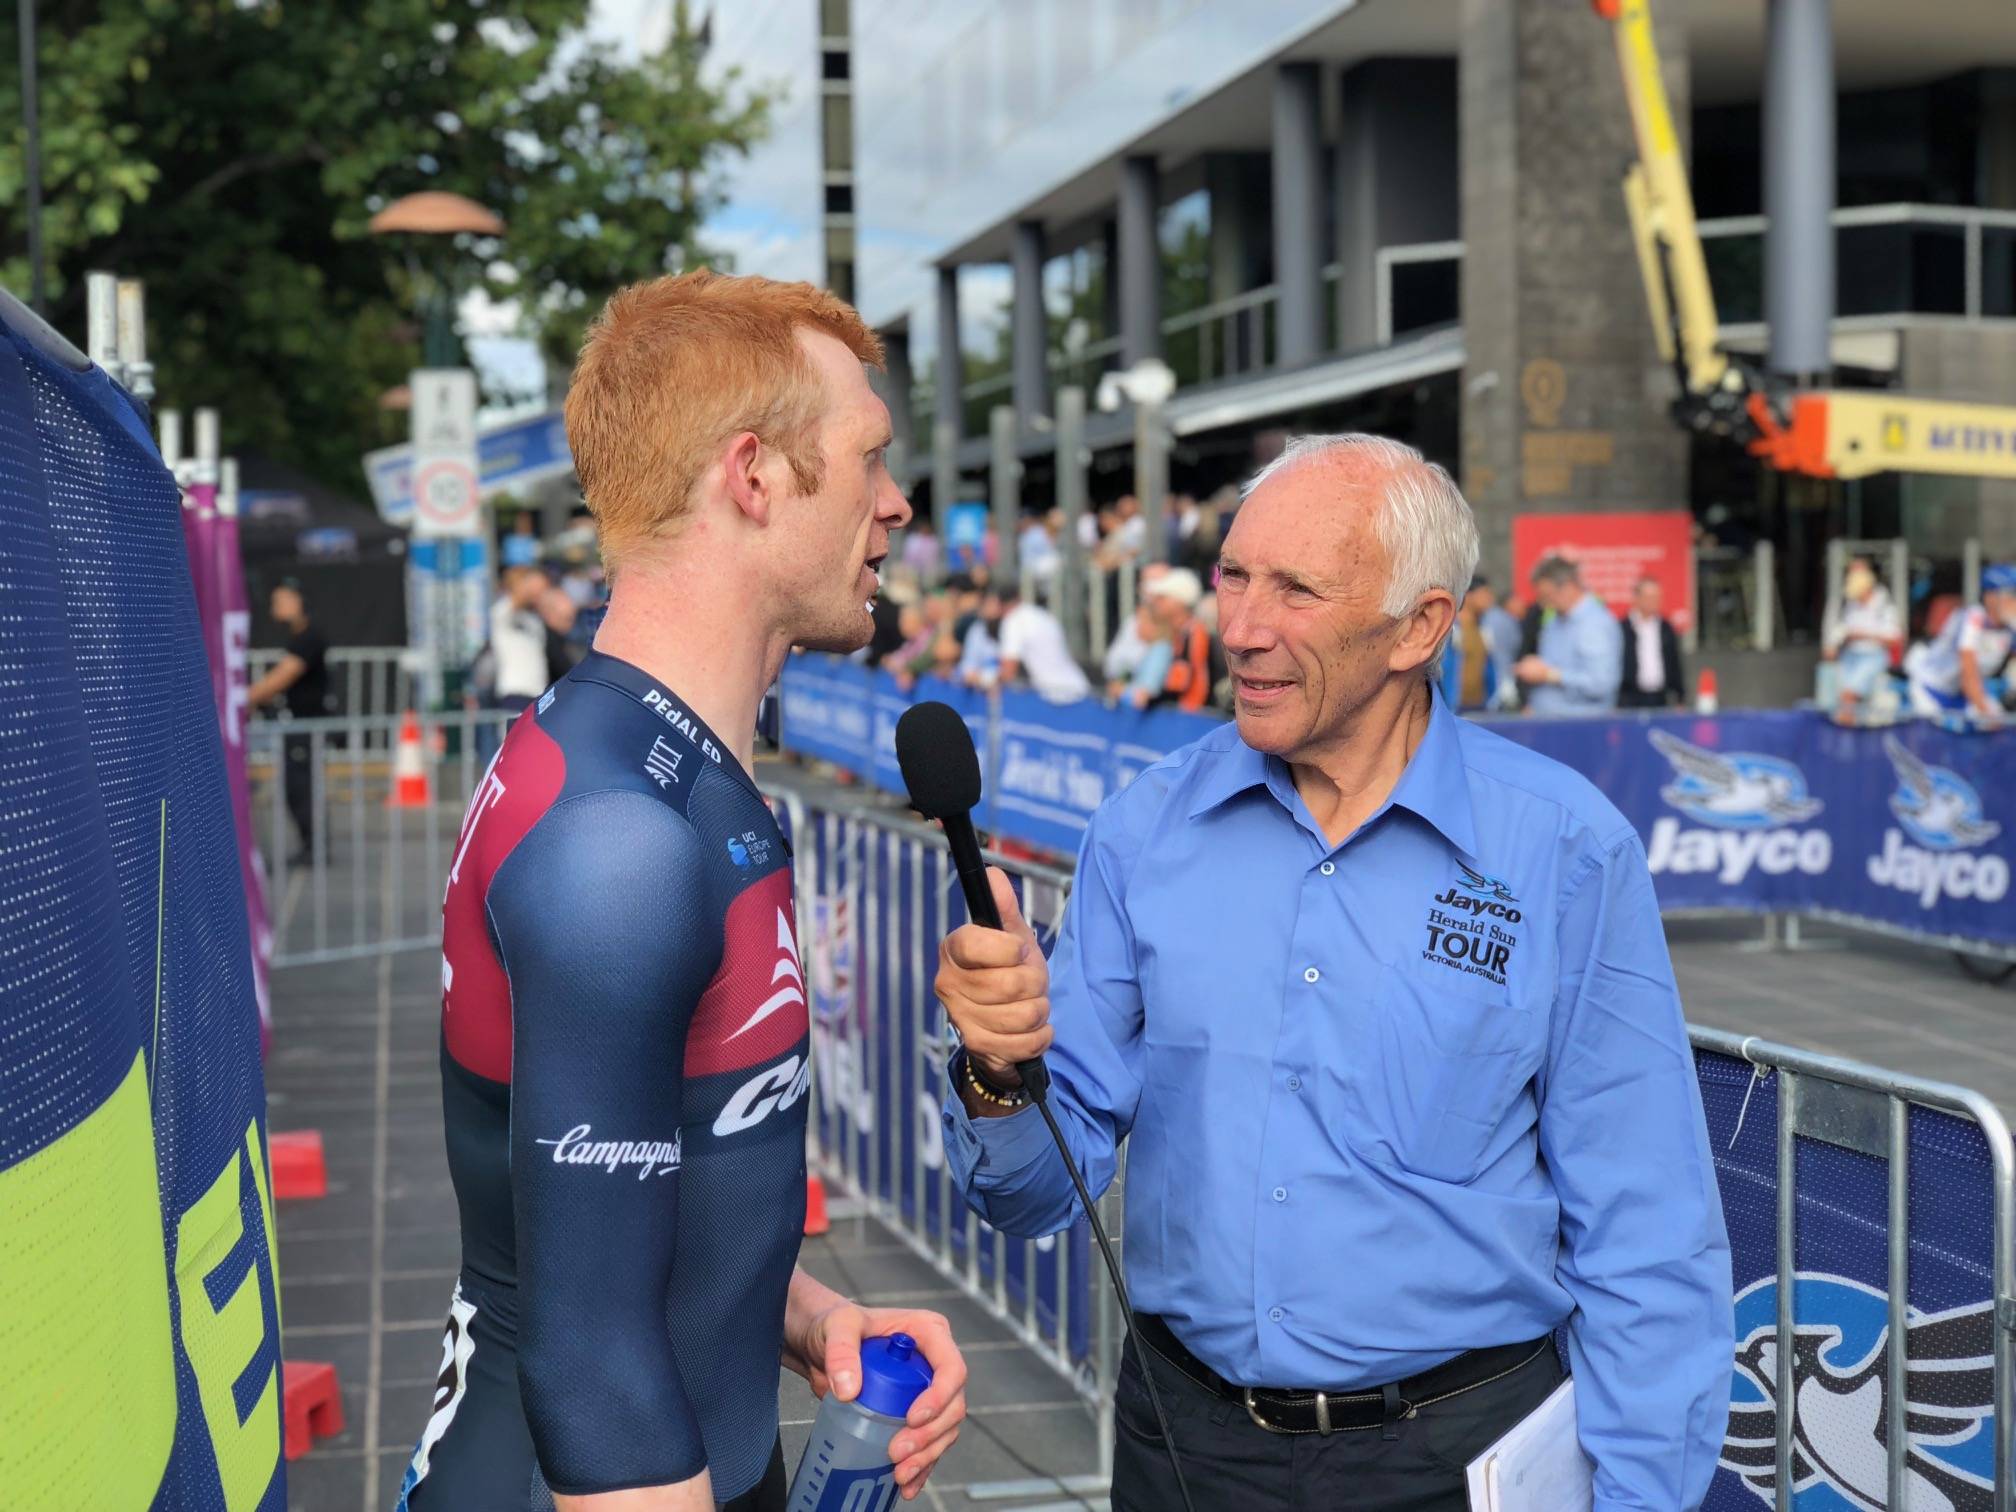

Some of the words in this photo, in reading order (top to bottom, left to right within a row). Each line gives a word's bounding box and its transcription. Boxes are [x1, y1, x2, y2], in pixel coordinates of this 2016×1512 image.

[646, 735, 683, 784] JLT
[702, 738, 722, 764] ED
[741, 831, 757, 843] UCI
[1648, 817, 1831, 885] Jayco
[1867, 828, 2009, 909] Jayco
[1434, 888, 1522, 923] Jayco
[1428, 908, 1485, 935] Herald
[1488, 924, 1517, 947] Sun
[1426, 924, 1510, 975] TOUR
[1464, 965, 1507, 986] AUSTRALIA
